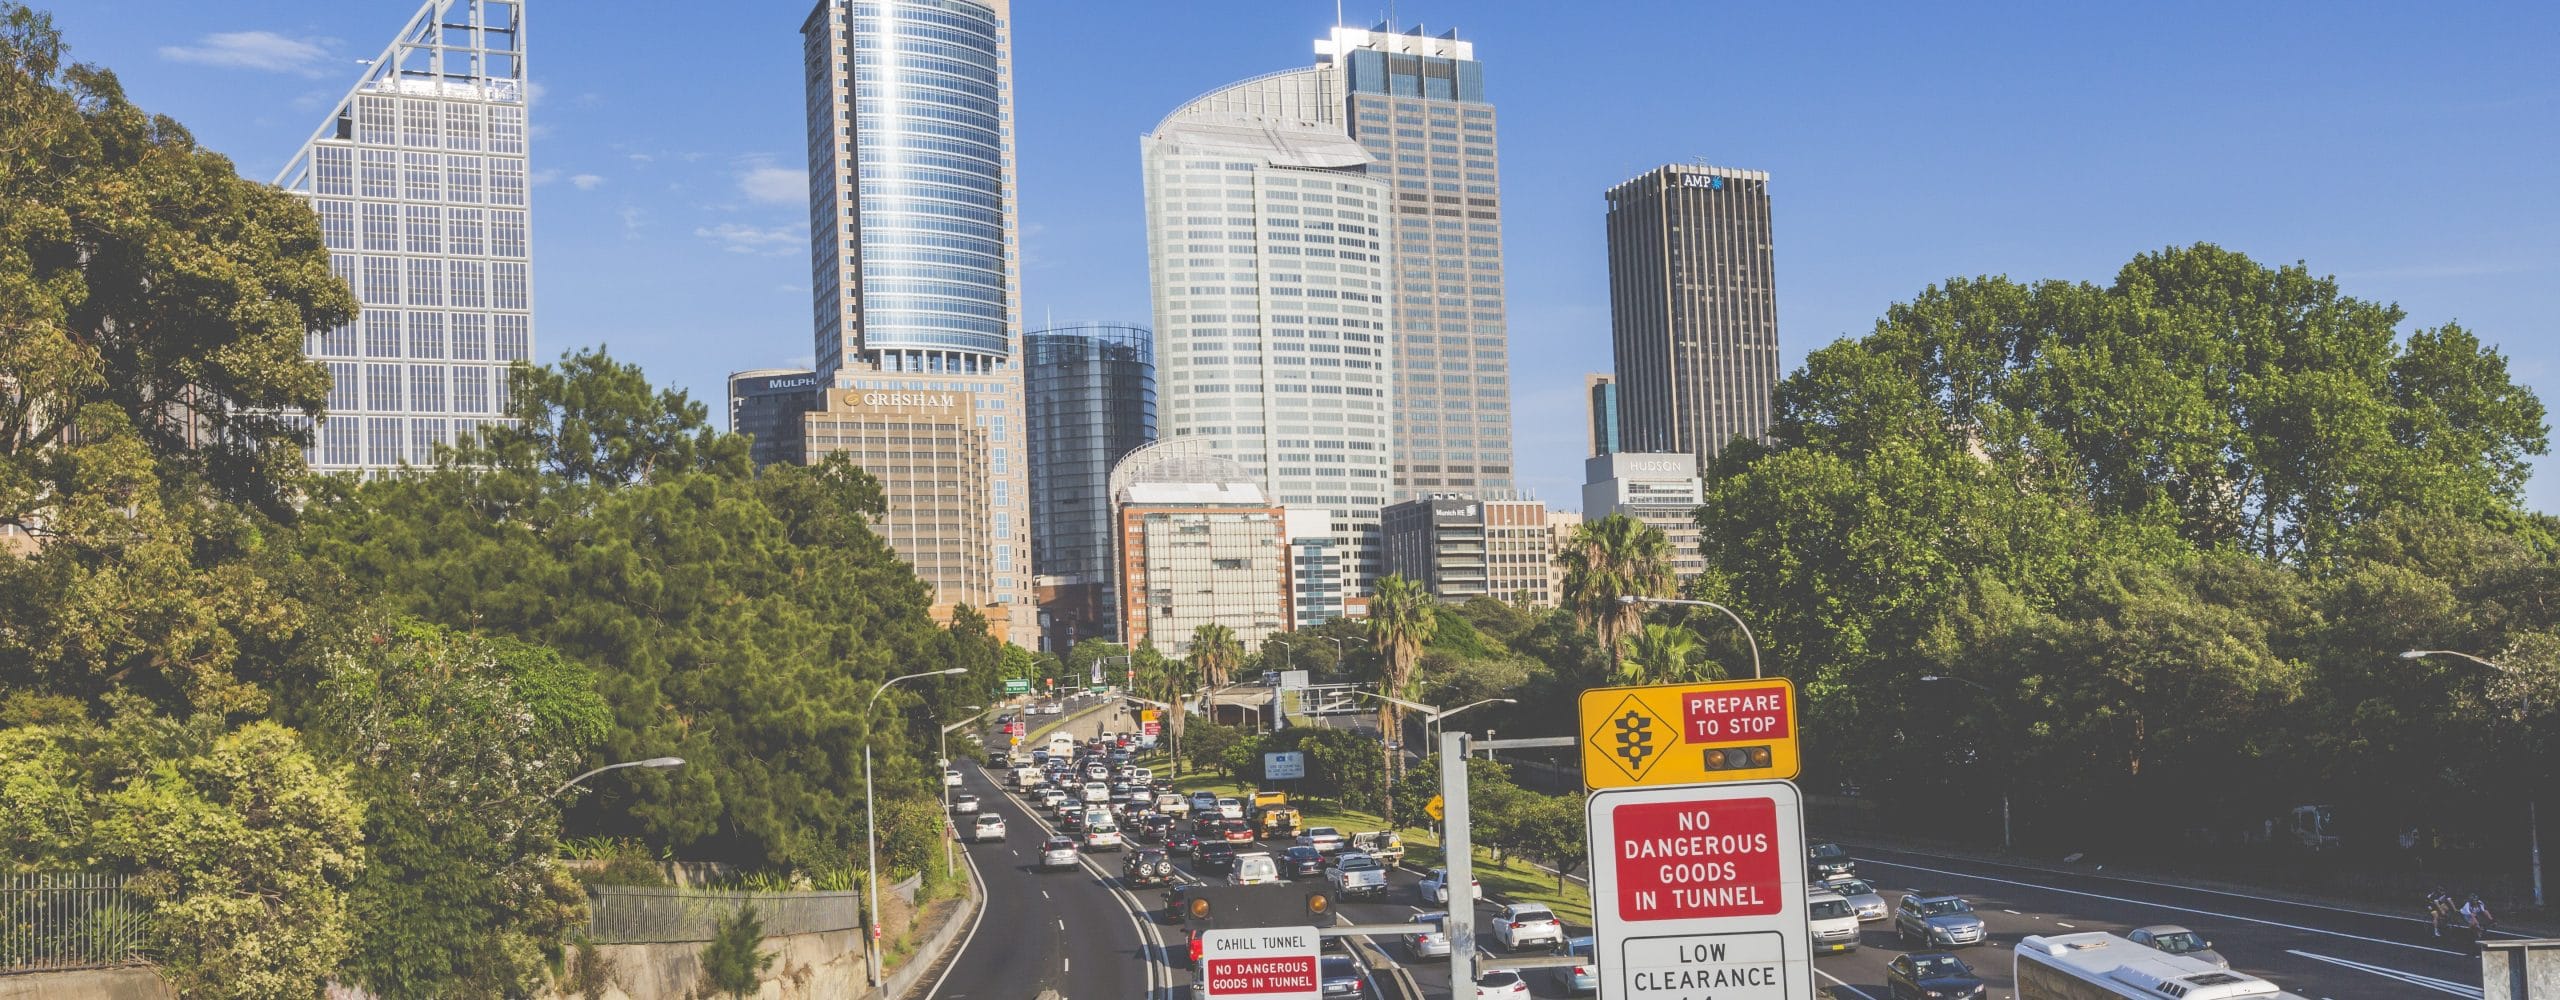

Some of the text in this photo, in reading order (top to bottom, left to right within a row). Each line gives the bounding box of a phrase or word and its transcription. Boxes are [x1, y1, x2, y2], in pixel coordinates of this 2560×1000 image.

[1684, 174, 1711, 188] AMP
[769, 377, 816, 389] MULPH
[863, 393, 954, 407] GRESHAM
[1630, 460, 1681, 472] HUDSON
[1691, 694, 1780, 715] PREPARE
[1696, 716, 1776, 736] TO STOP
[1678, 811, 1710, 831] NO
[1625, 833, 1768, 859] DANGEROUS
[1659, 861, 1736, 884] GOODS
[1635, 886, 1764, 911] IN TUNNEL
[1217, 936, 1306, 951] CAHILL TUNNEL
[1679, 943, 1726, 964] LOW
[1216, 962, 1308, 975] NO DANGEROUS
[1212, 976, 1313, 990] GOODS IN TUNNEL
[1634, 967, 1776, 992] CLEARANCE
